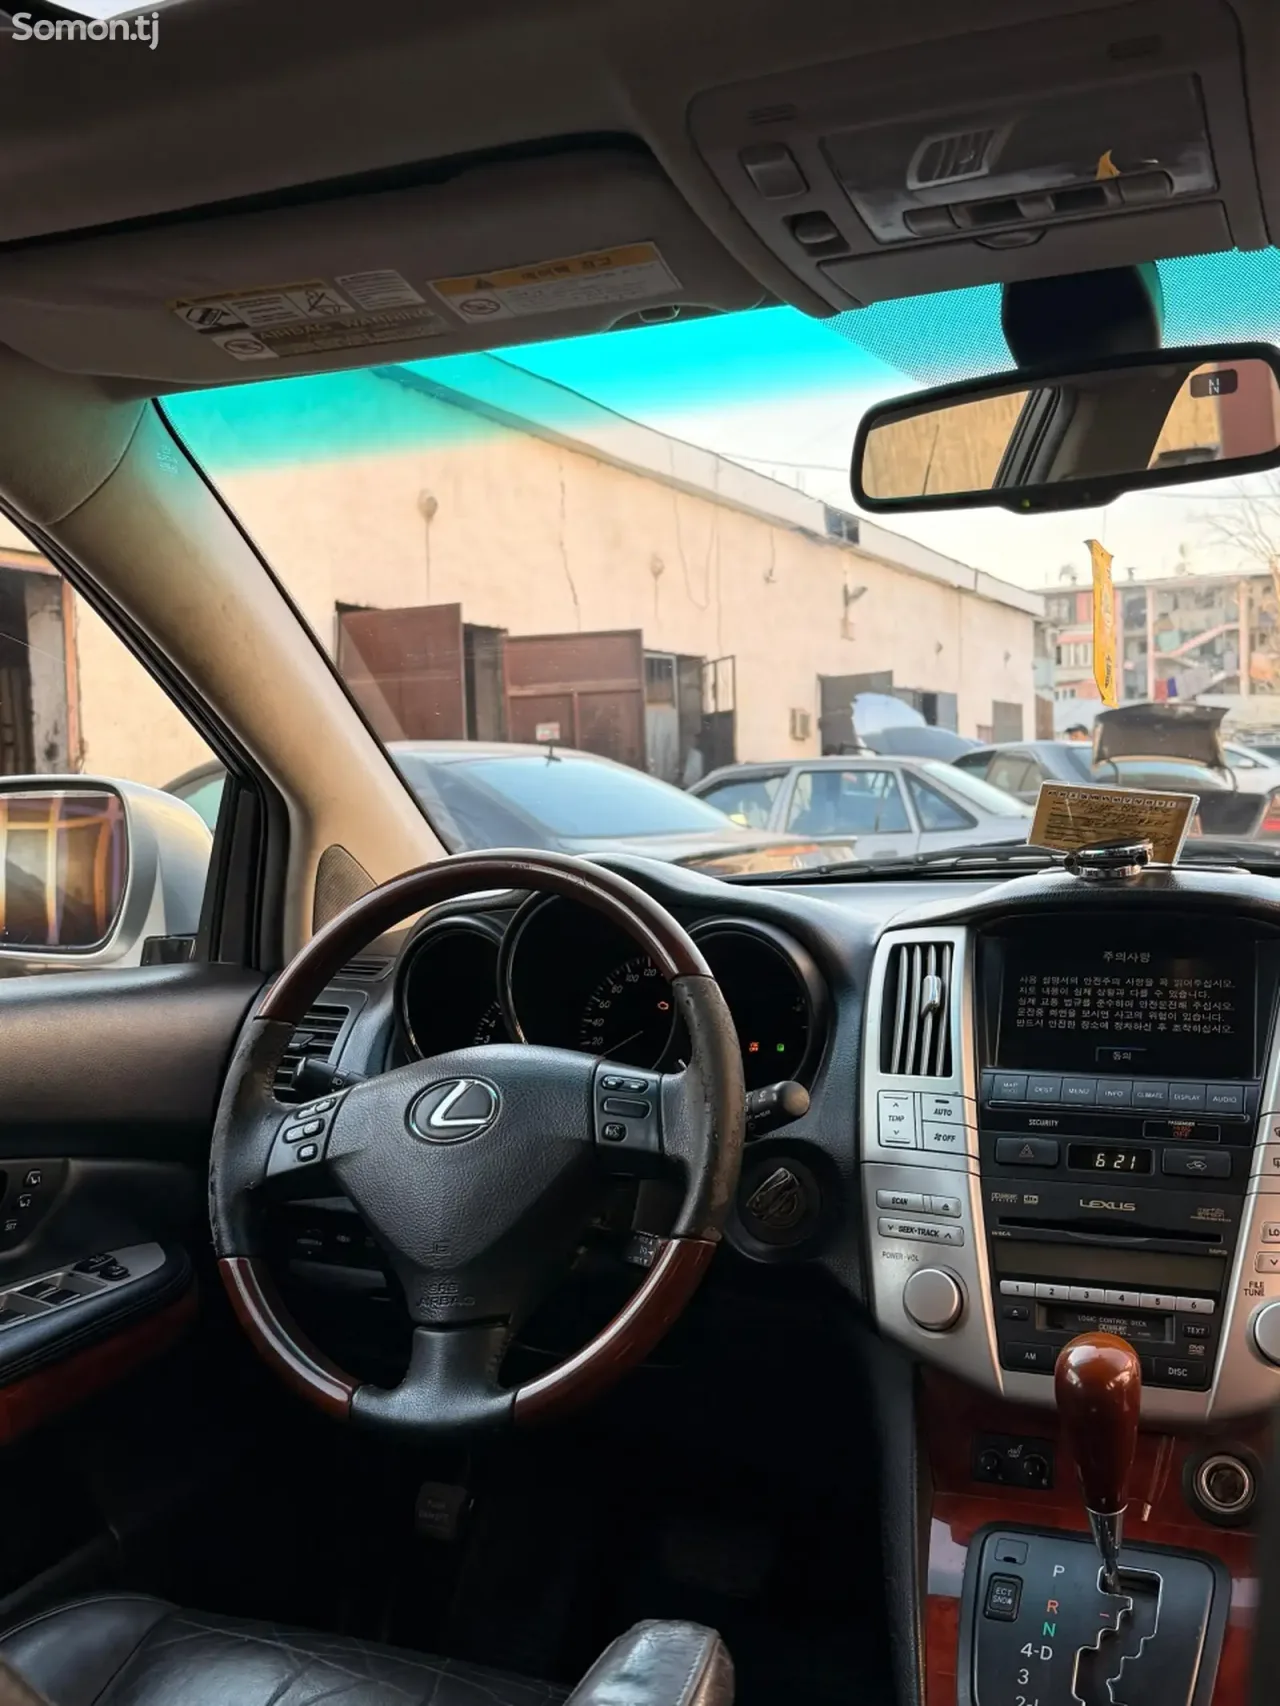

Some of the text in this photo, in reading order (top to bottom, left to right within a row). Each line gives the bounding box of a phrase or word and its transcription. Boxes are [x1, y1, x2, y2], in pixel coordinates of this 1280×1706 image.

[1208, 378, 1220, 396] N
[1103, 950, 1151, 963] 주의사항
[644, 968, 656, 977] 120
[626, 973, 639, 982] 100
[1020, 975, 1037, 984] 사용
[611, 985, 623, 994] 80
[1154, 990, 1163, 998] 수
[1169, 990, 1210, 999] 있습니다.
[600, 1000, 611, 1009] 60
[592, 1018, 604, 1027] 40
[1016, 1019, 1044, 1028] 반드시
[484, 1035, 491, 1043] 3
[592, 1037, 603, 1045] 20
[1113, 1051, 1132, 1060] 동의
[1173, 1093, 1200, 1102] DISPLAY
[1212, 1095, 1237, 1104] AUDIO
[933, 1108, 952, 1116] AUTO
[1029, 1118, 1059, 1127] SECURITY
[892, 1197, 908, 1205] SCAN
[1079, 1199, 1136, 1212] LEXUS
[1244, 1288, 1264, 1296] TUNE
[1098, 1317, 1128, 1325] CONTROL
[1024, 1351, 1037, 1360] AM
[1168, 1368, 1188, 1376] DISC
[1052, 1566, 1064, 1578] P
[996, 1587, 1012, 1596] ECT
[993, 1594, 1012, 1605] SNOW
[1047, 1600, 1059, 1613] R
[1043, 1622, 1056, 1637] N
[1020, 1642, 1053, 1660] 4-D
[1017, 1668, 1029, 1685] 3
